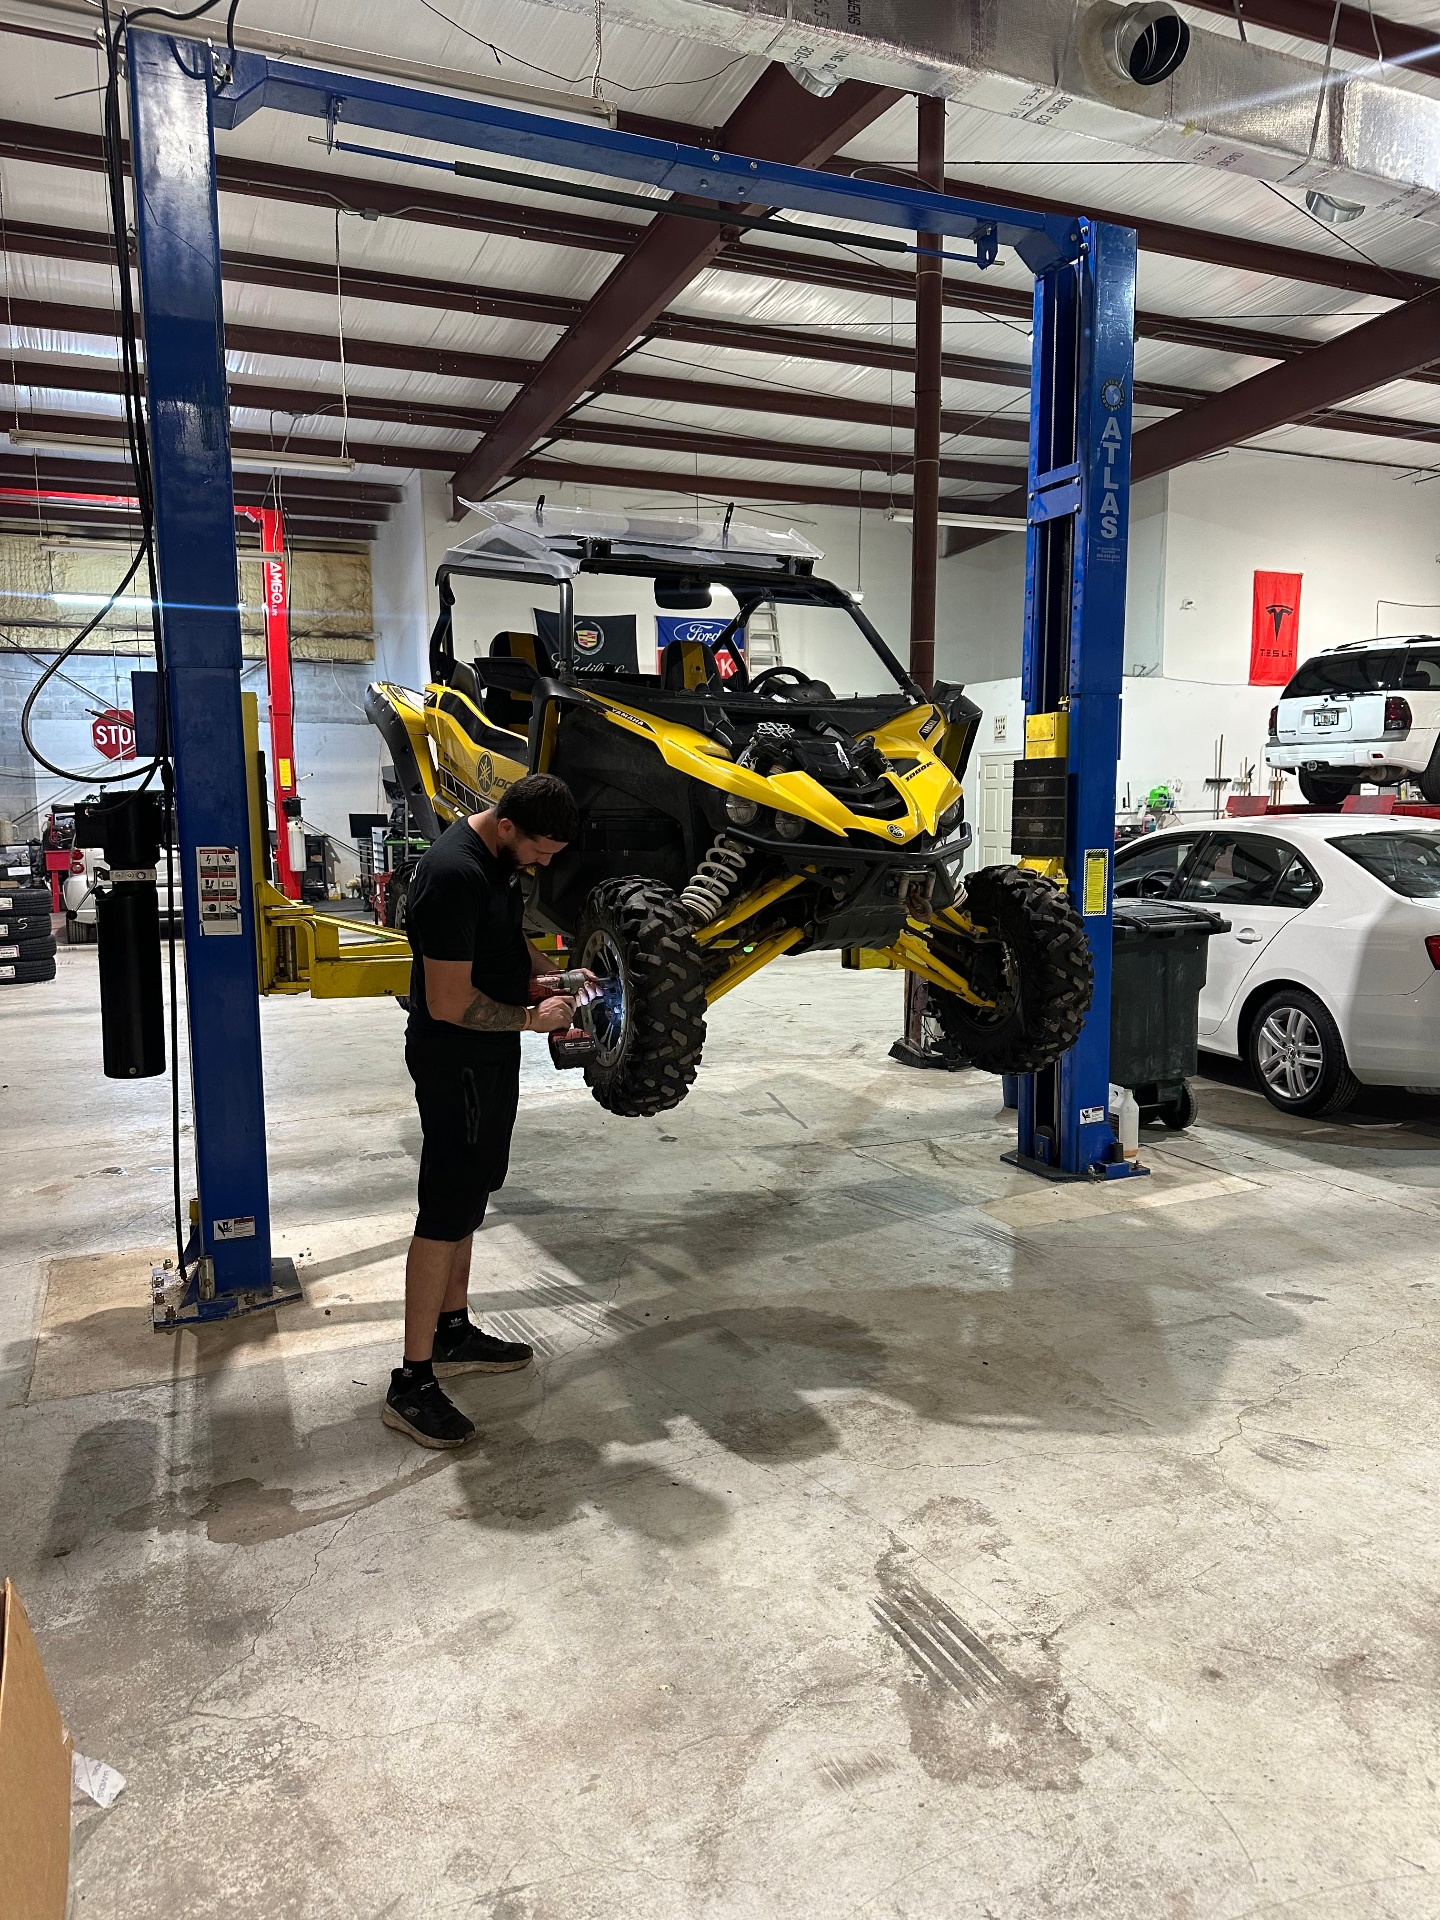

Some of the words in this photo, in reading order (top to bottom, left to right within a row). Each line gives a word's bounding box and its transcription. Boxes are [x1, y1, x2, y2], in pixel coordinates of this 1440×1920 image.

[1100, 416, 1122, 539] ATLAS
[269, 561, 284, 604] AMGO
[684, 623, 722, 642] Ford
[1260, 648, 1293, 658] TESLA
